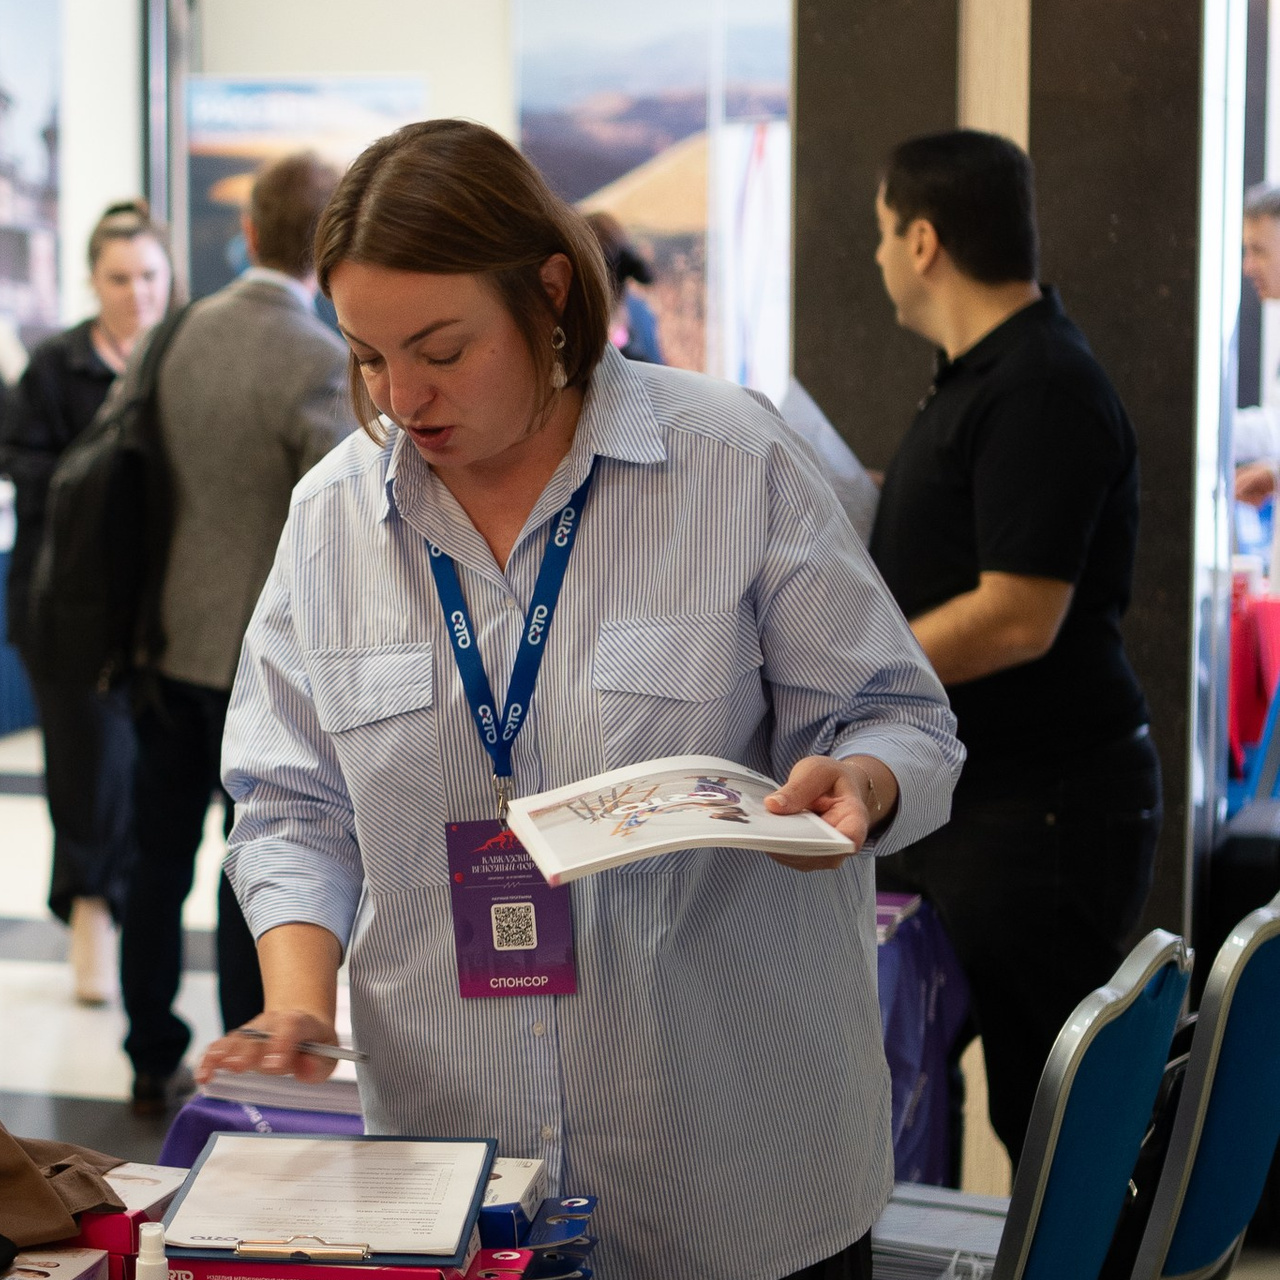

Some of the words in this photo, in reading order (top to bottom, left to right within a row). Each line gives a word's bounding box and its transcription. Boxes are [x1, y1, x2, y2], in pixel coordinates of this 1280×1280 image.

[554, 506, 576, 547] ORTO
[451, 610, 471, 649] ORTO
[527, 604, 548, 646] ORTO
[478, 704, 498, 745] ORTO
[502, 702, 522, 742] ORTO
[472, 862, 516, 874] ВЕНОЗНЫЙ
[489, 976, 549, 989] СПОНСОР
